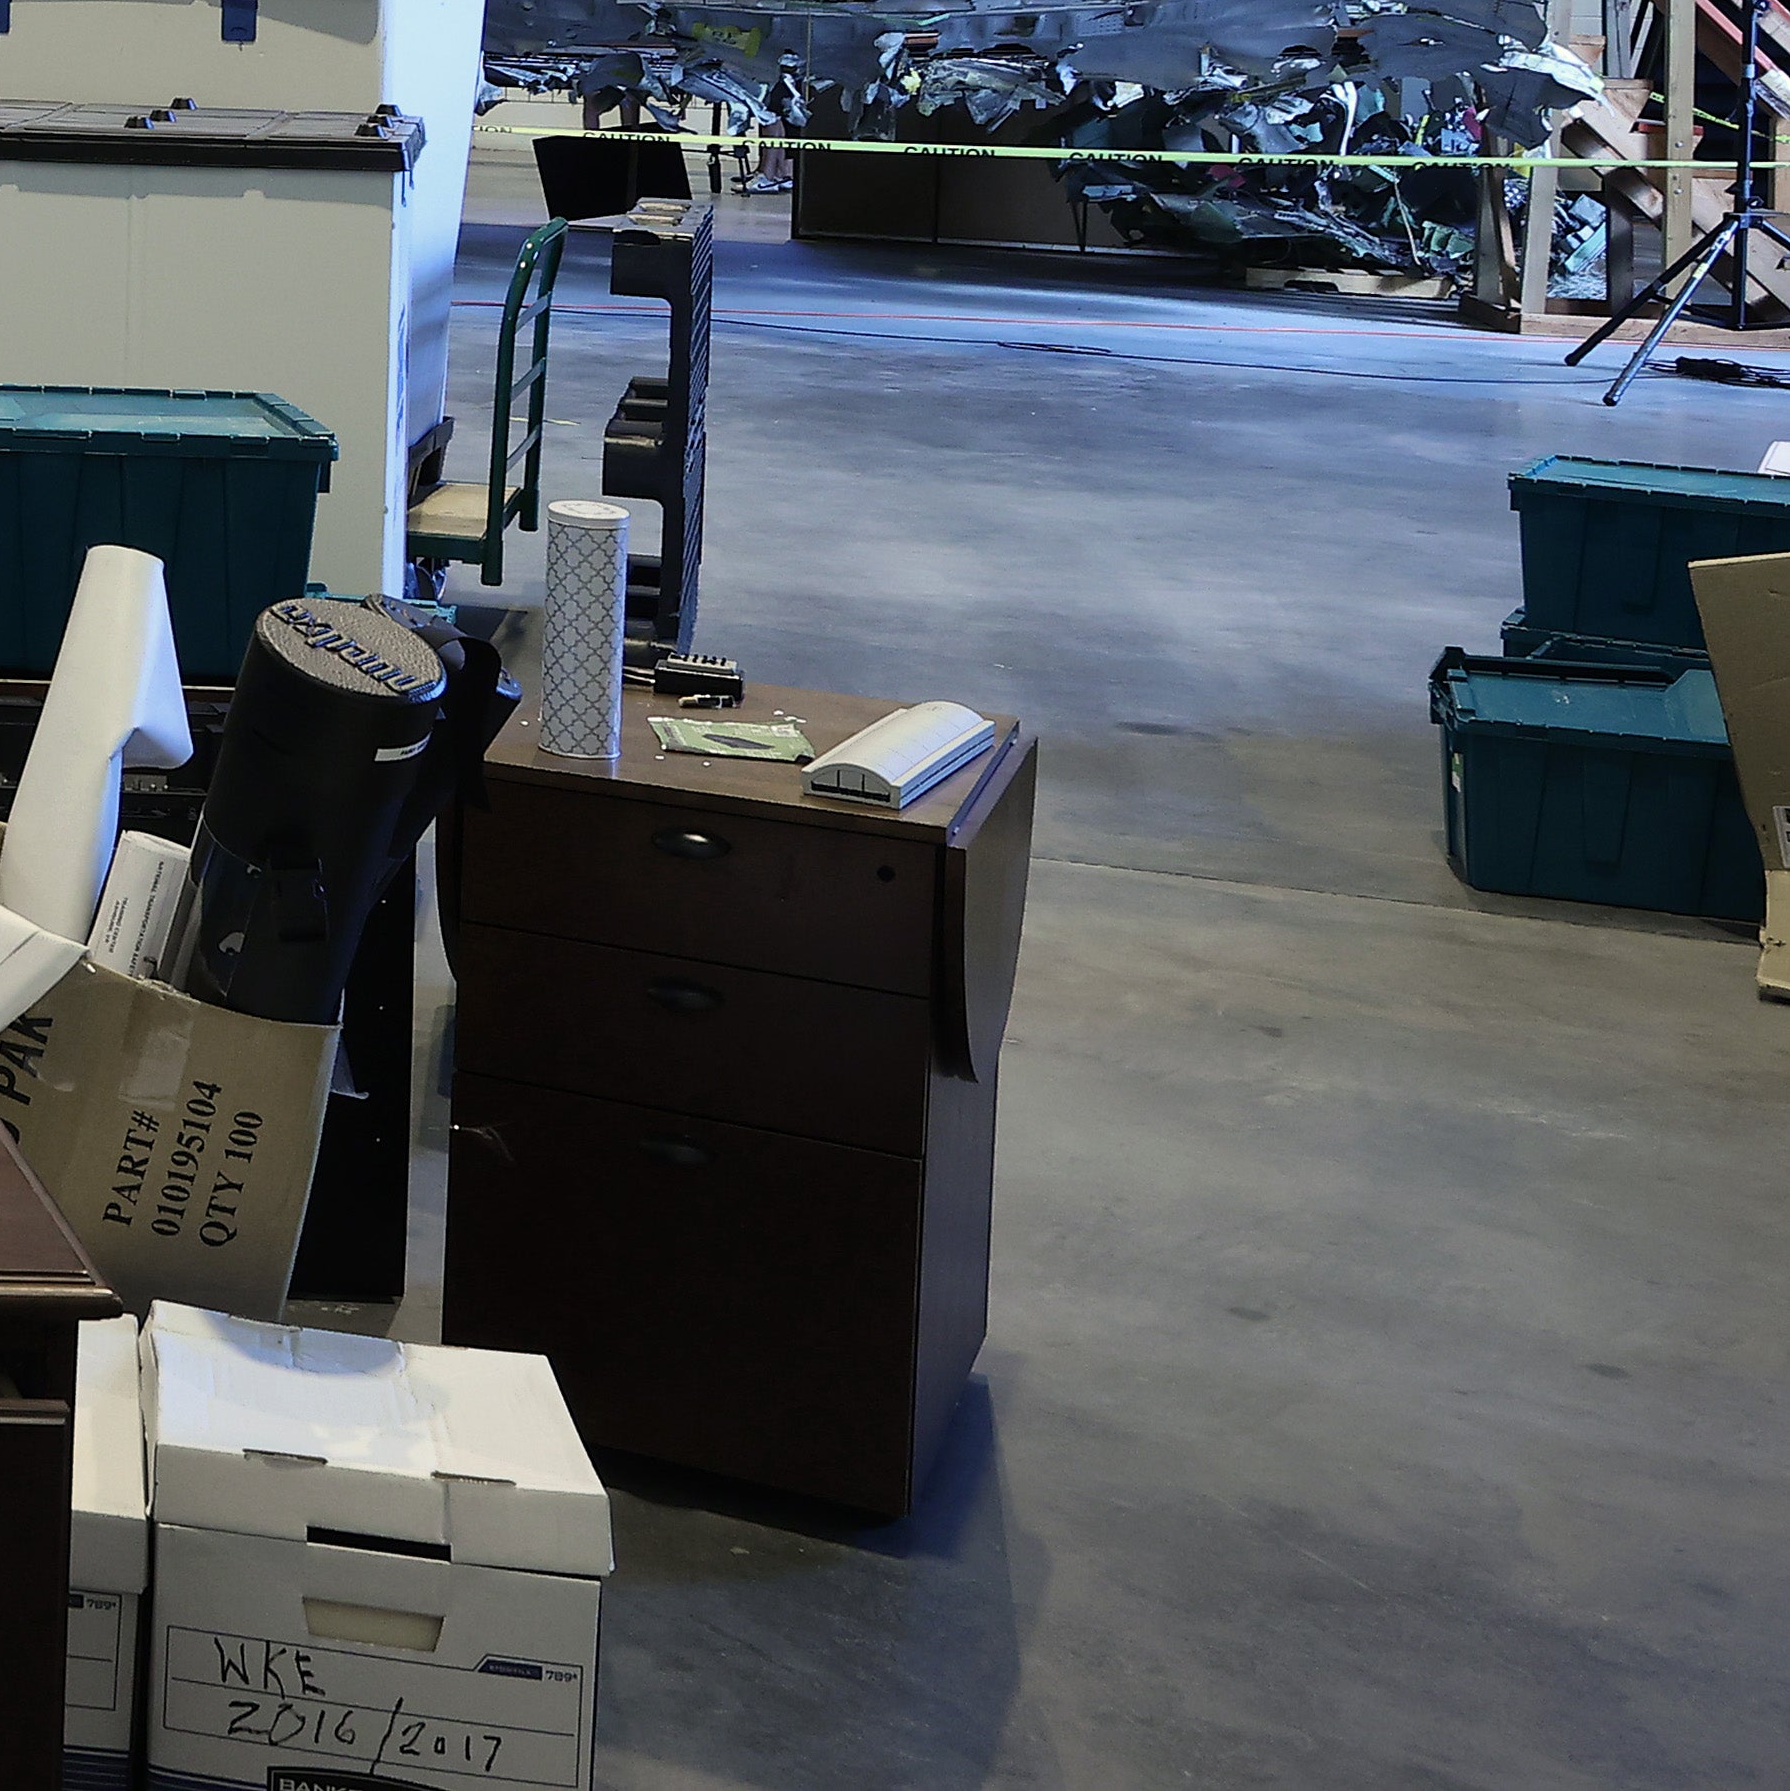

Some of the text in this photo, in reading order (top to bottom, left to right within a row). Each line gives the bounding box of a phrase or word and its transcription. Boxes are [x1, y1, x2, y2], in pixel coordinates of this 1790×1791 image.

[904, 146, 995, 158] CAUTION
[151, 860, 165, 893] NATIONAL
[109, 897, 129, 954] TRAINING CENTER
[135, 894, 156, 952] TRANSPORTATION
[103, 1109, 164, 1228] PART#
[151, 1077, 223, 1238] 010195104
[199, 1110, 265, 1248] QTY 100
[214, 1637, 326, 1699] WKE
[228, 1697, 503, 1775] 2016/2017
